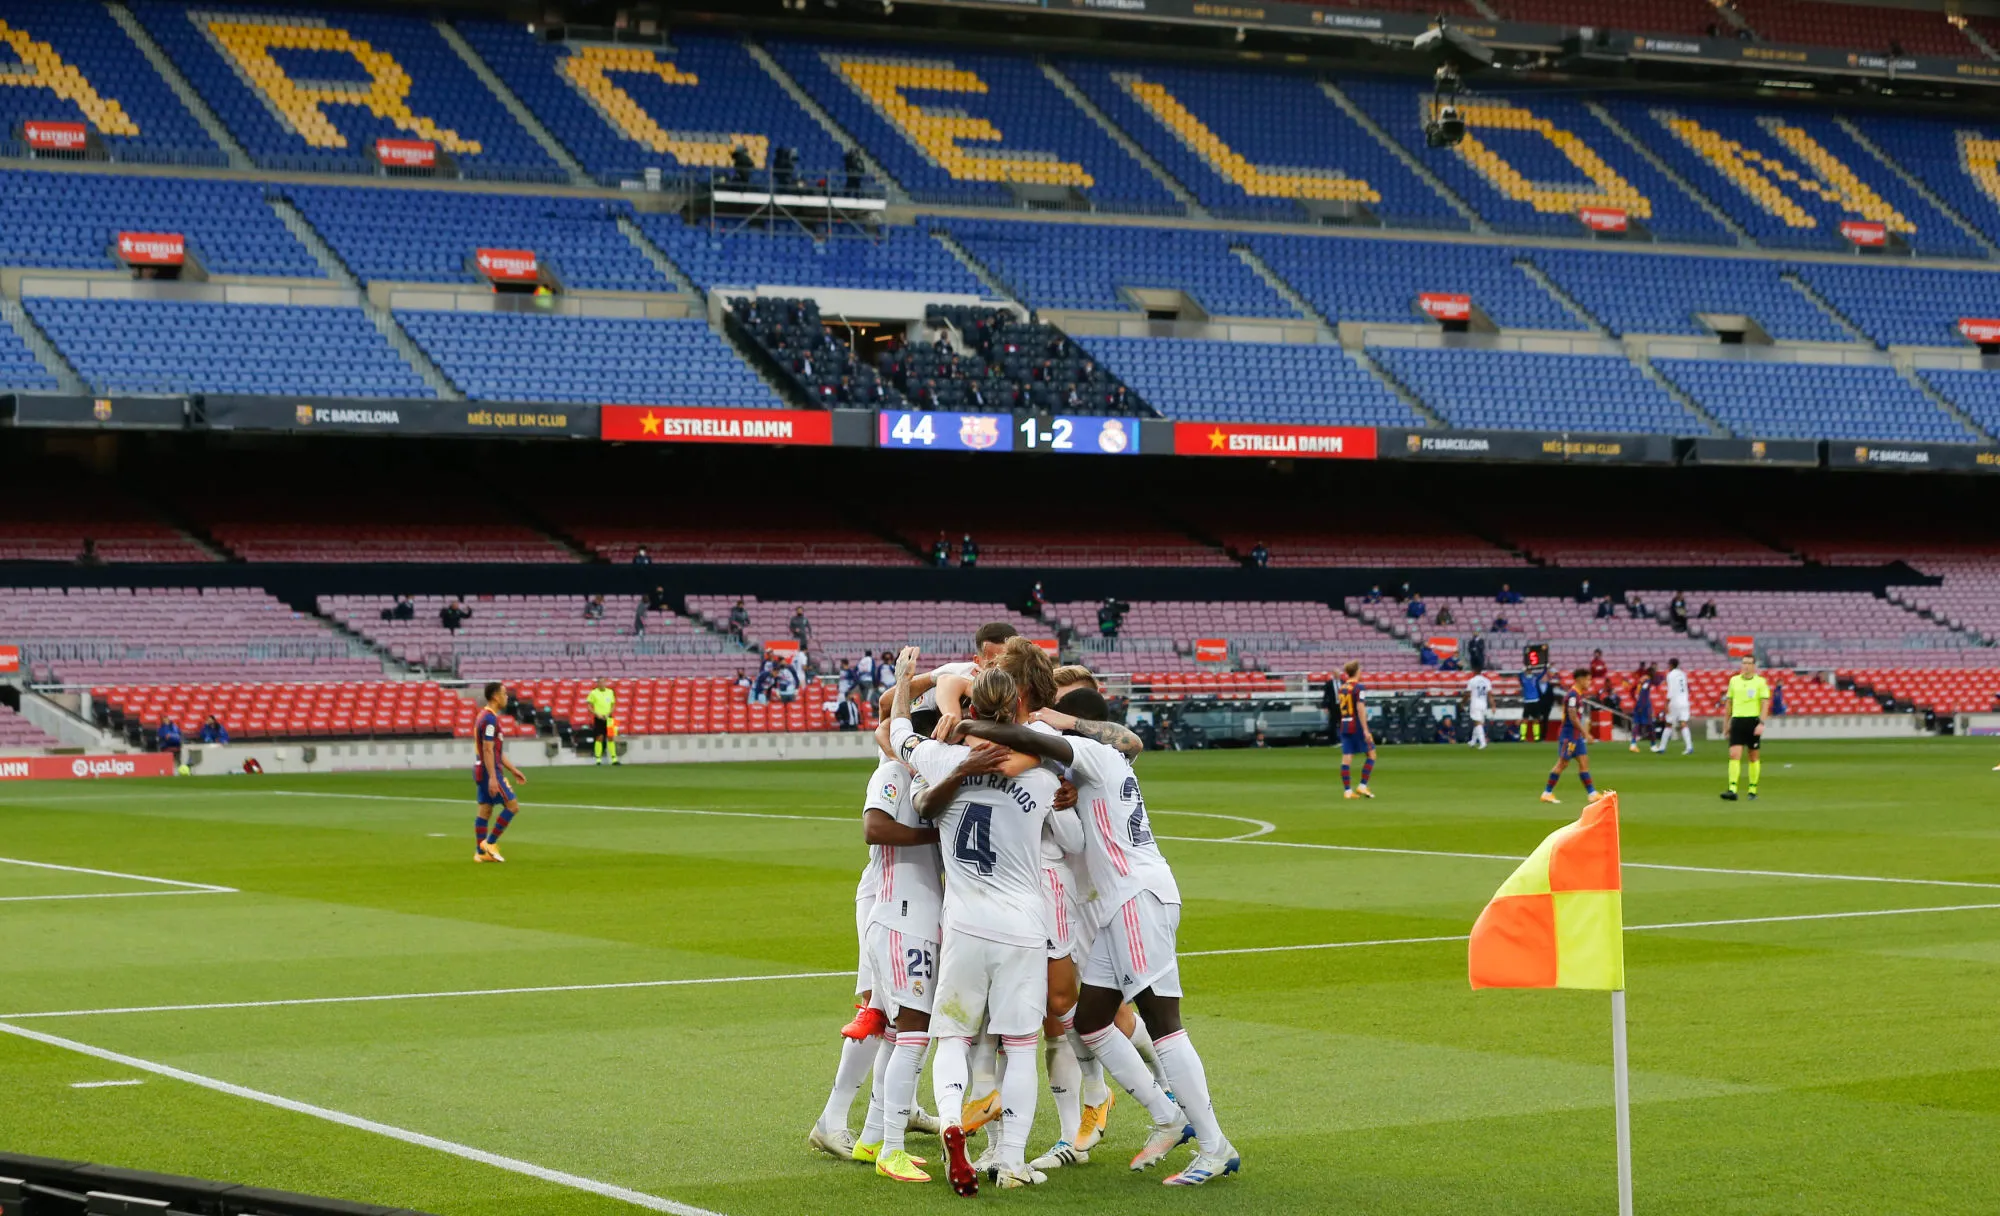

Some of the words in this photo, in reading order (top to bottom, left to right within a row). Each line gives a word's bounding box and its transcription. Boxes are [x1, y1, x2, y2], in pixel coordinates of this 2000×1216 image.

[316, 408, 330, 422] FC
[331, 409, 399, 424] BARCELONA
[467, 409, 493, 425] MÉS
[494, 412, 517, 428] QUE
[519, 413, 536, 426] UN
[538, 414, 566, 427] CLUB
[664, 418, 741, 436] ESTRELLA
[742, 420, 793, 438] DAMM
[892, 414, 935, 445] 44
[1020, 418, 1073, 449] 1-2
[1229, 434, 1296, 451] ESTRELLA
[1299, 436, 1342, 452] DAMM
[1422, 438, 1433, 450] FC
[1434, 438, 1489, 451] BARCELONA
[1869, 450, 1879, 461] FC
[1880, 451, 1928, 463] BARCELONA
[1338, 694, 1353, 715] 21
[90, 759, 134, 775] LaLiga
[986, 773, 1037, 813] RAMOS
[952, 801, 997, 876] 4
[907, 948, 933, 979] 25
